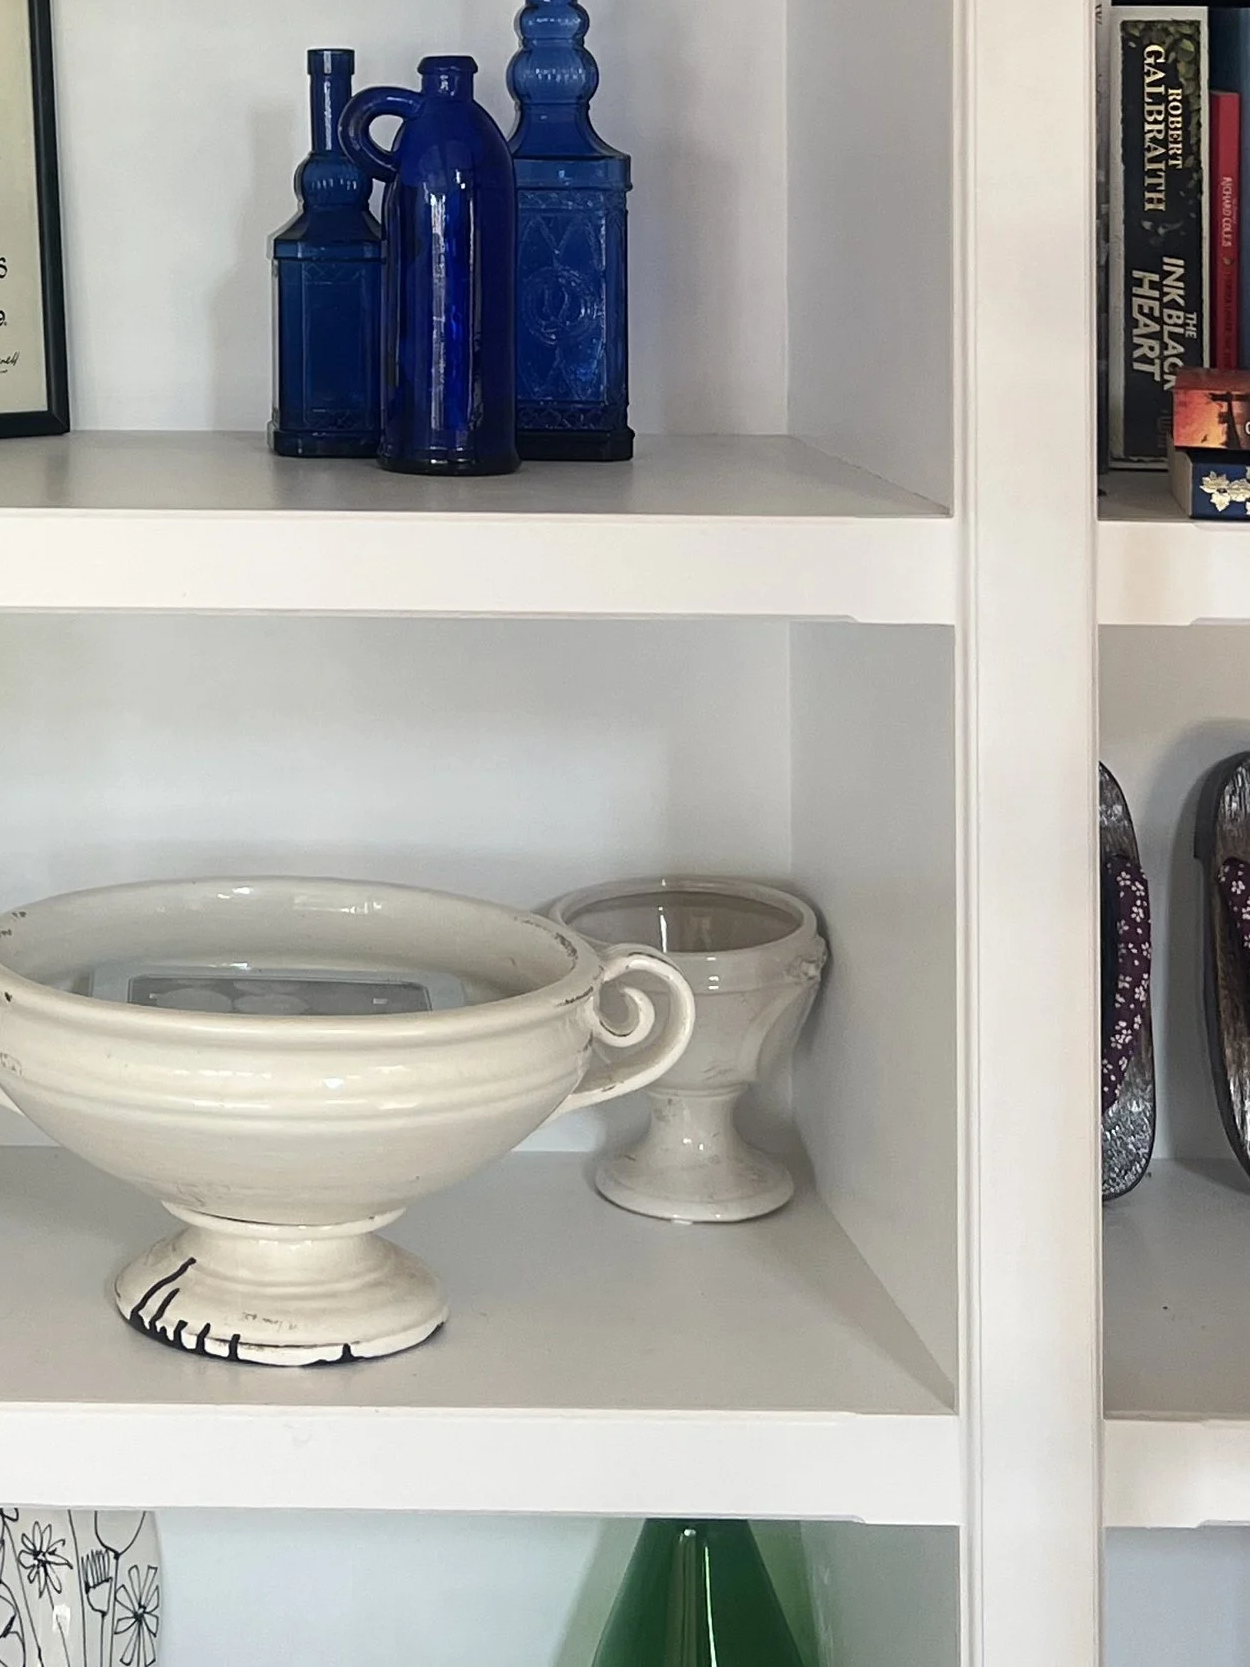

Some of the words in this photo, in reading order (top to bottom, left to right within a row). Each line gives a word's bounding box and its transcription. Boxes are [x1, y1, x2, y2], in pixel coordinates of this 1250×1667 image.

[1143, 44, 1167, 212] GALBRAITH
[1167, 87, 1184, 169] ROBERT
[1162, 256, 1186, 306] INK
[1131, 269, 1162, 383] HEART
[1184, 311, 1198, 340] THE
